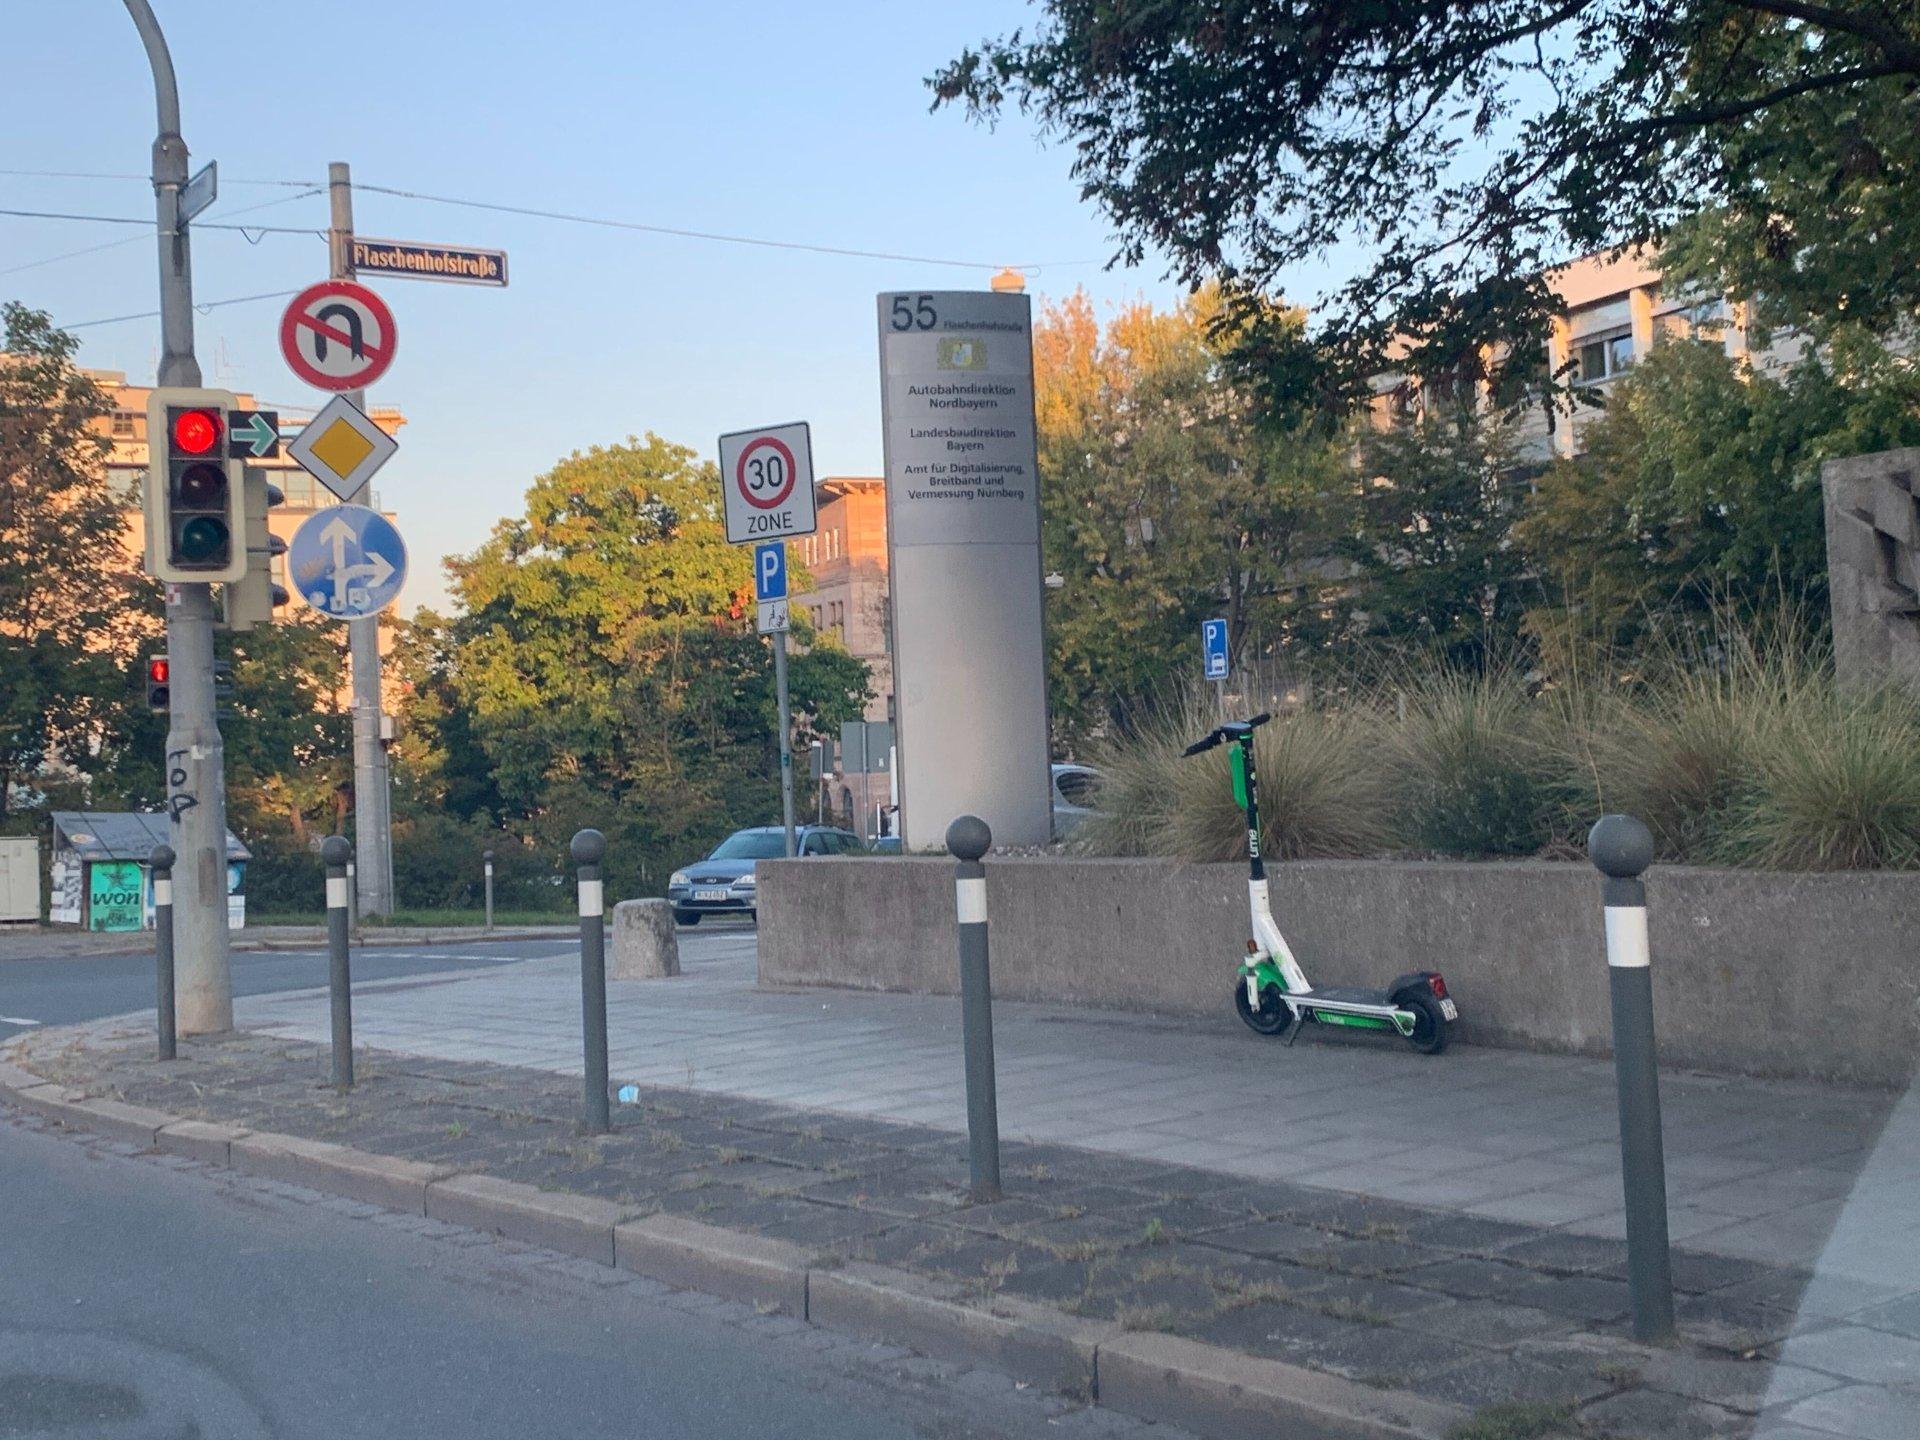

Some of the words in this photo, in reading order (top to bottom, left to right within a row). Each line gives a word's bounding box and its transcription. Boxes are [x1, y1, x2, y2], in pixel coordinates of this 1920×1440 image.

[353, 243, 498, 278] Flaschenhofstraße
[891, 294, 937, 331] 55
[908, 383, 1016, 395] Autobahndirektion
[929, 398, 998, 411] Nordbayern
[910, 427, 1016, 439] Landesbaudirektion
[946, 440, 985, 452] Bayern
[749, 455, 783, 490] 30
[904, 464, 929, 474] Amt
[931, 463, 946, 474] für
[929, 475, 981, 487] Breitband
[983, 475, 1005, 486] und
[908, 489, 974, 500] Vermessung
[748, 511, 793, 534] ZONE
[761, 550, 779, 593] P
[1206, 625, 1217, 648] P
